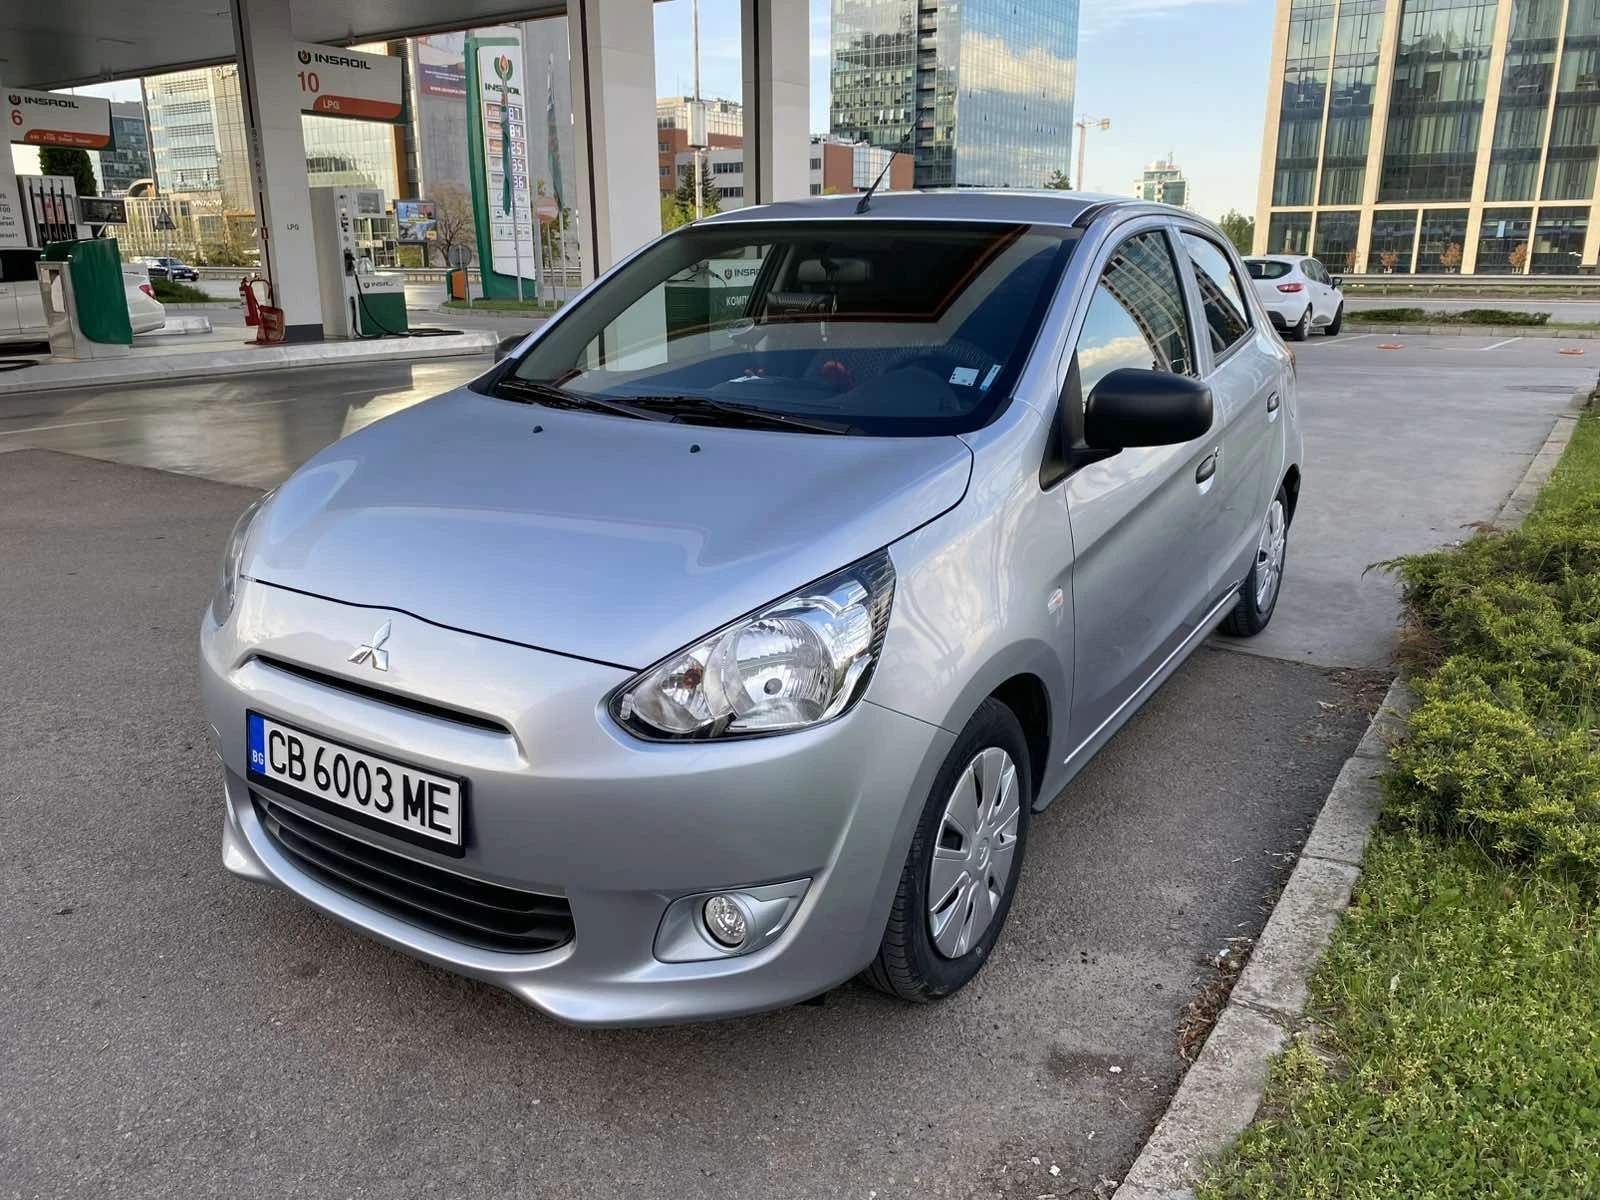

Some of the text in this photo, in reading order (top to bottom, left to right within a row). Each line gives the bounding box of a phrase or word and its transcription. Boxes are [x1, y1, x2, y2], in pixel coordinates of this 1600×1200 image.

[315, 53, 372, 70] INSAOIL
[297, 71, 320, 93] 10
[24, 96, 79, 109] INSAOIL
[322, 99, 341, 110] LPG
[11, 109, 24, 126] 6
[286, 223, 300, 231] LPG
[734, 268, 761, 277] INSA
[726, 295, 750, 306] КОМП
[252, 749, 265, 766] BG
[268, 729, 452, 836] CB 6003 ME
